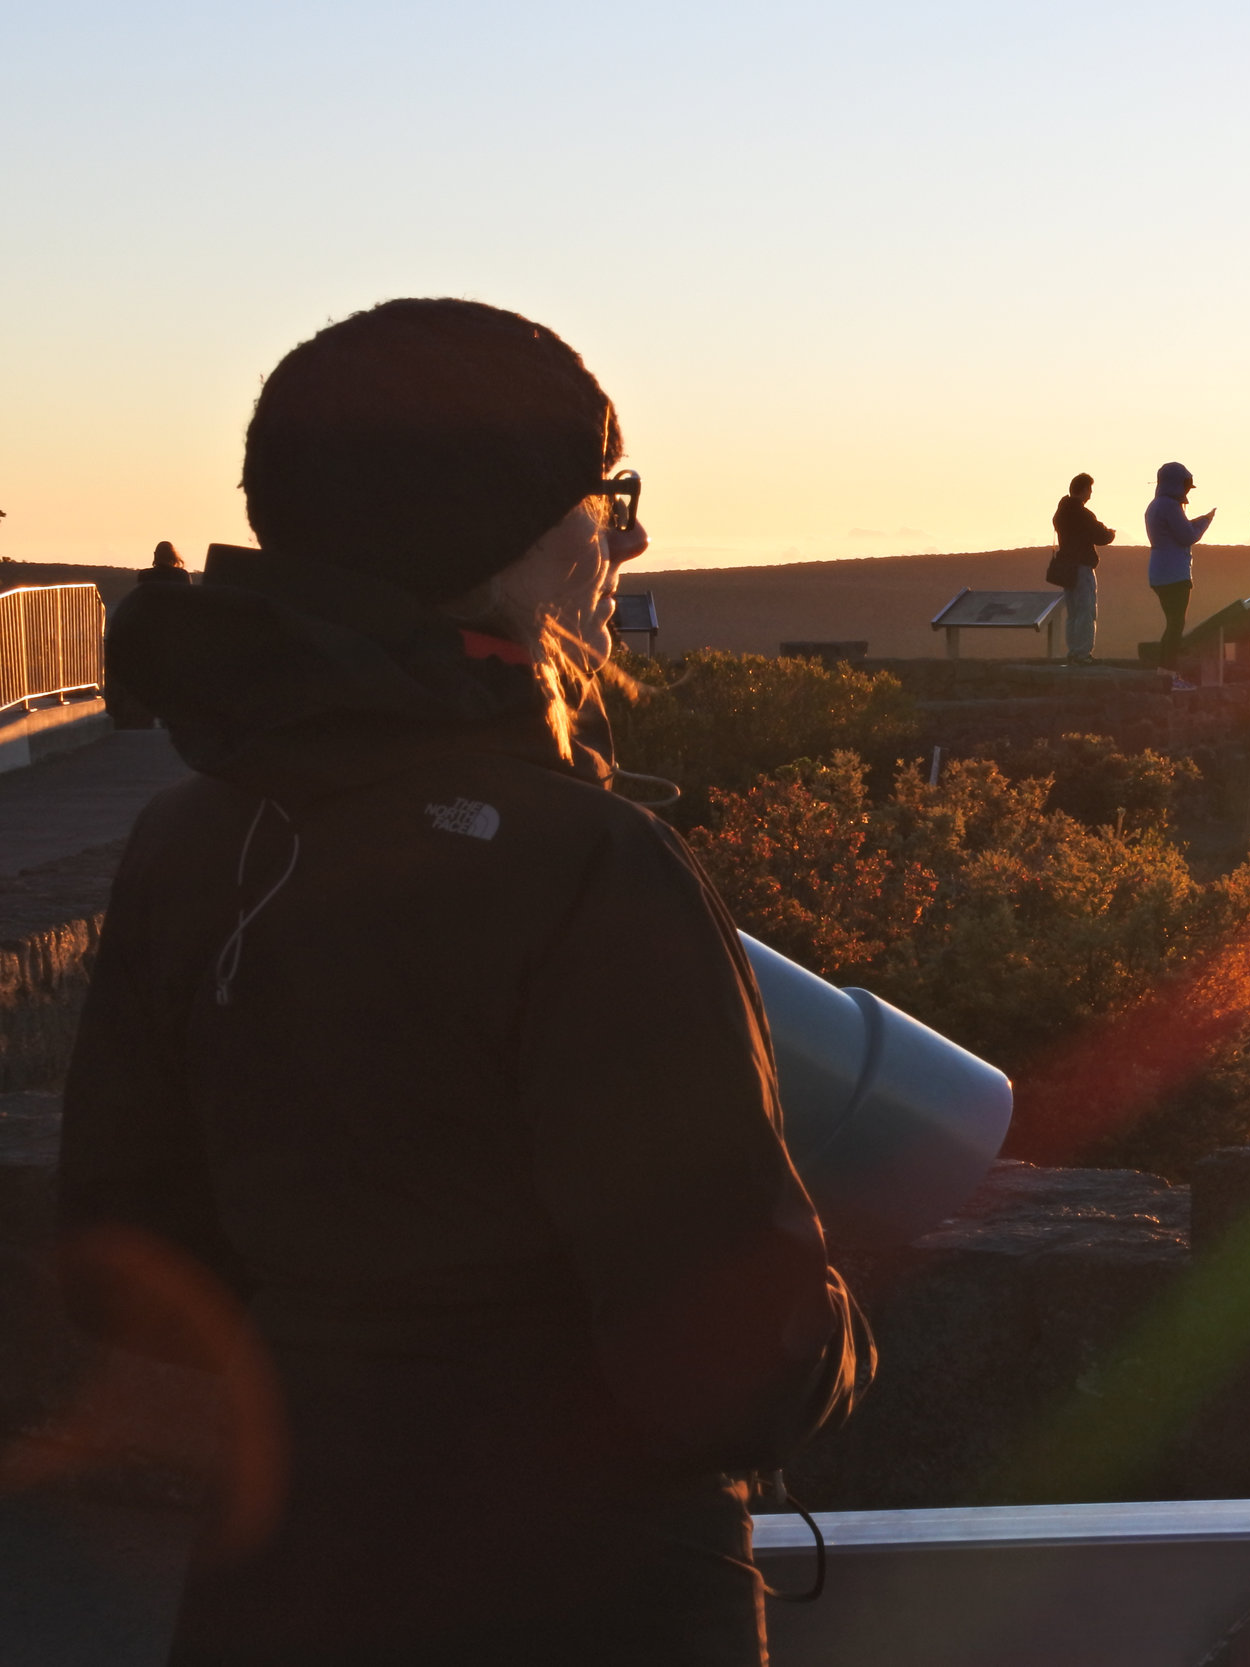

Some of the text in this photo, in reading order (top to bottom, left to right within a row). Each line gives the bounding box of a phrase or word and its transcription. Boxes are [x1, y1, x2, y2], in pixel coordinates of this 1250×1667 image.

[455, 797, 483, 812] THE
[424, 803, 476, 824] NORTH
[432, 817, 470, 833] FACE
